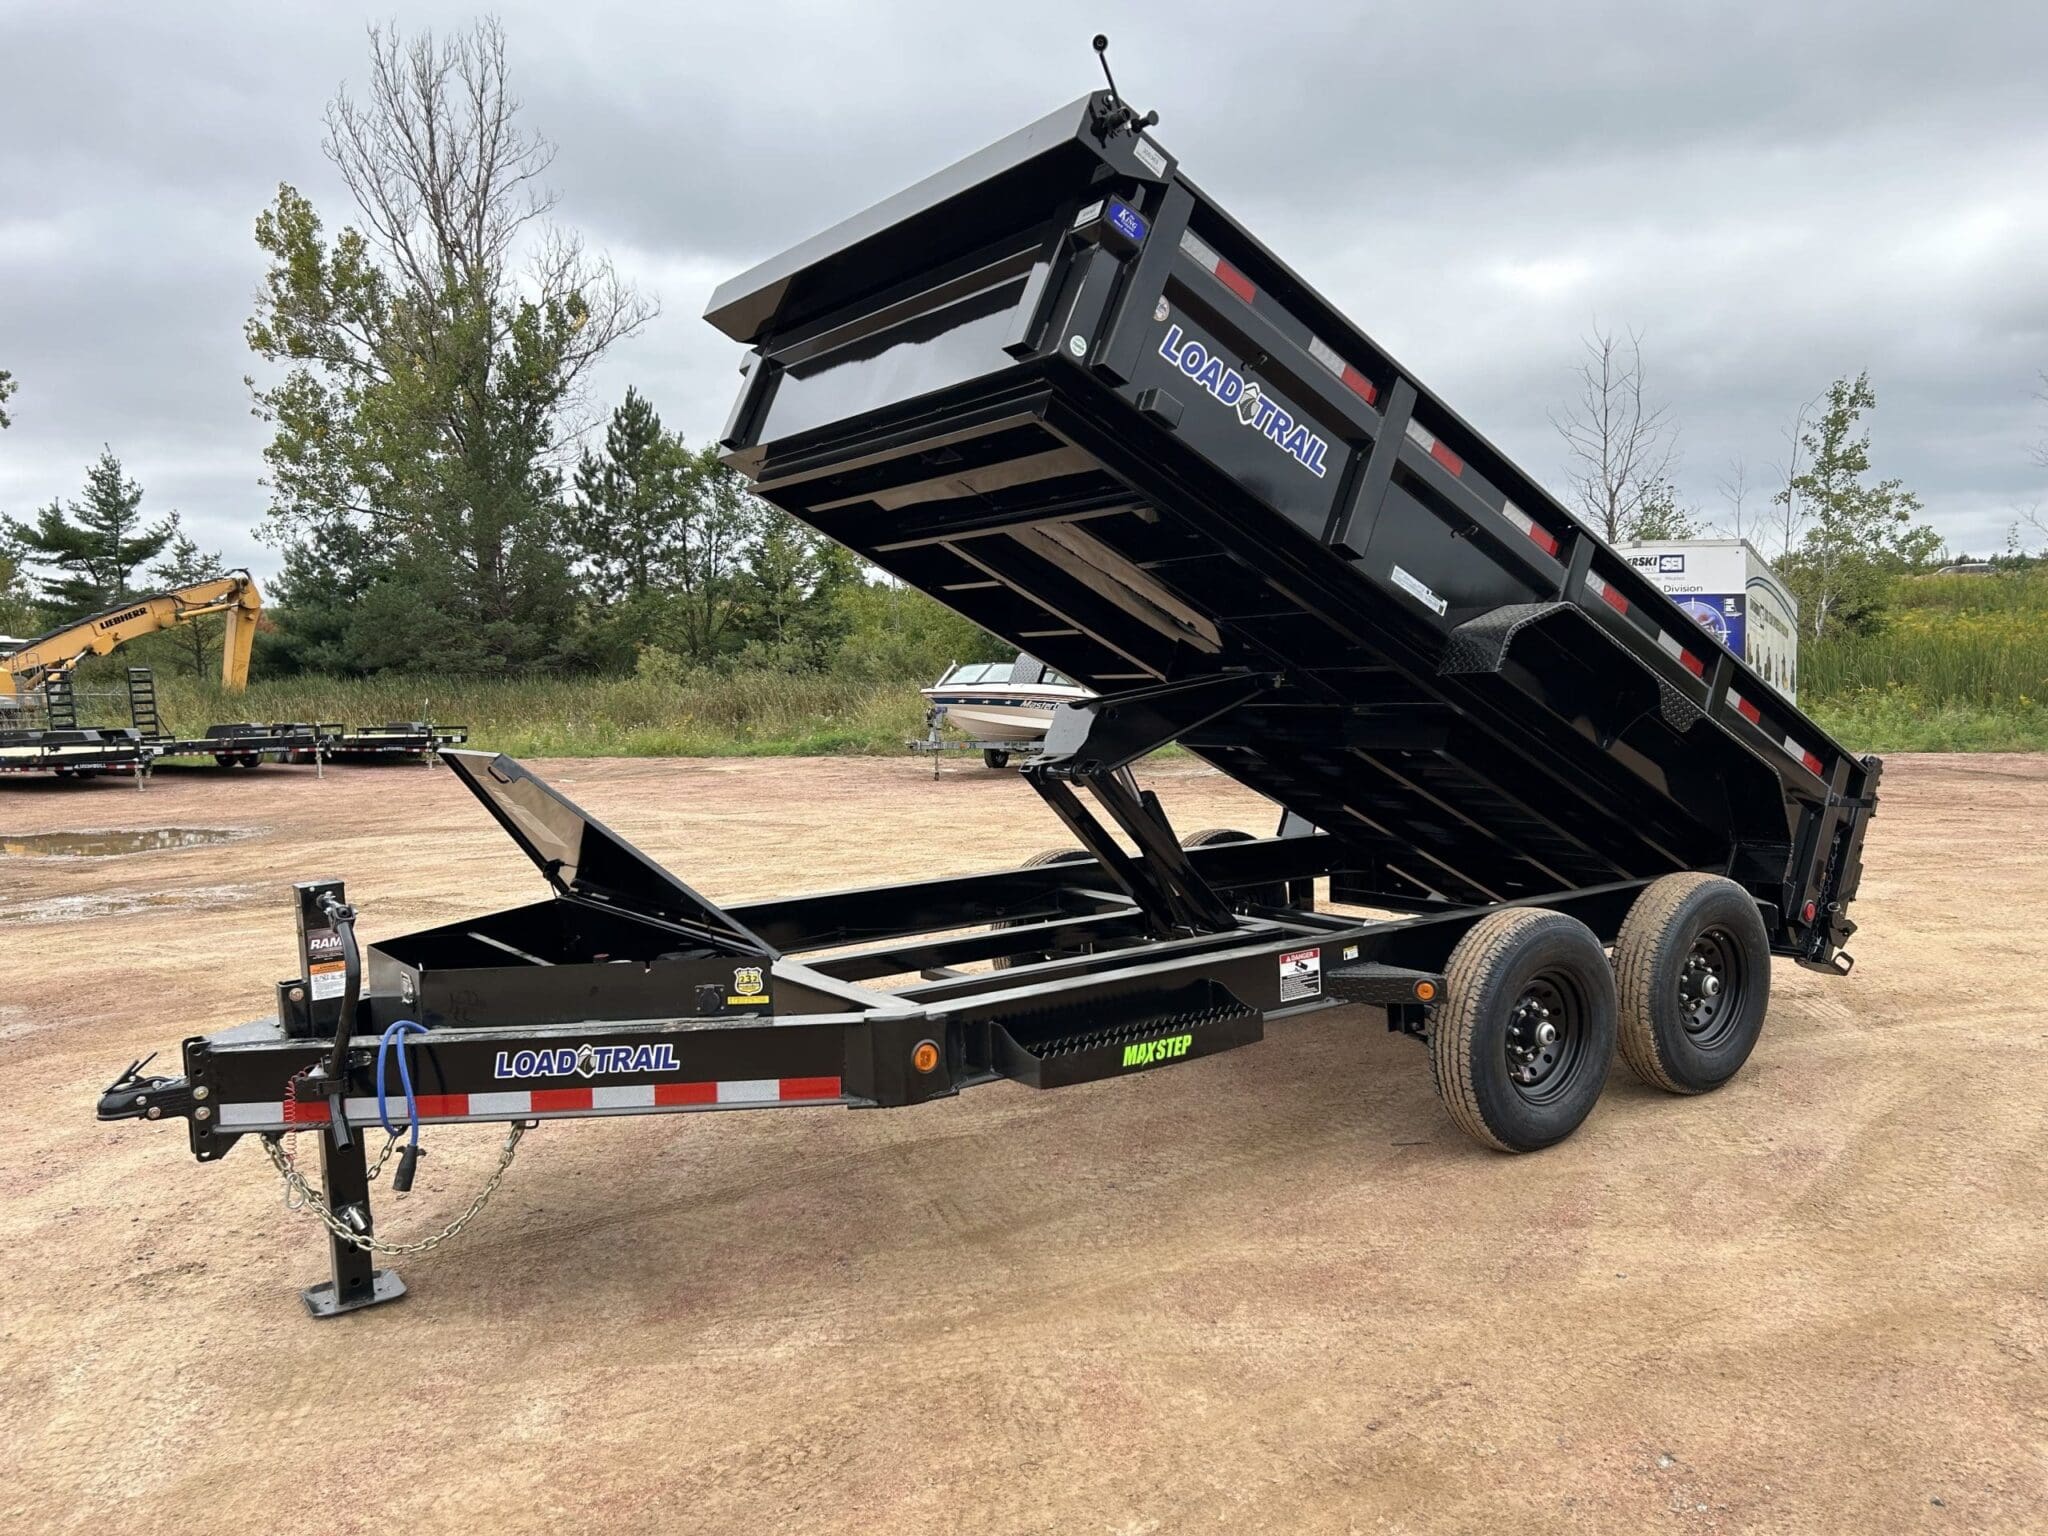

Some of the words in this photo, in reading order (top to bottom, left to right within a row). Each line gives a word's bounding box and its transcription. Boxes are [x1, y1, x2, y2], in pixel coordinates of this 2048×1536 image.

[1159, 324, 1244, 406] LOAD
[1251, 392, 1328, 478] TRAIL
[1664, 584, 1703, 592] Division
[100, 607, 148, 630] LIEBHERR
[310, 937, 343, 950] RAM
[494, 1048, 577, 1079] LOAD
[592, 1044, 681, 1074] TRAIL
